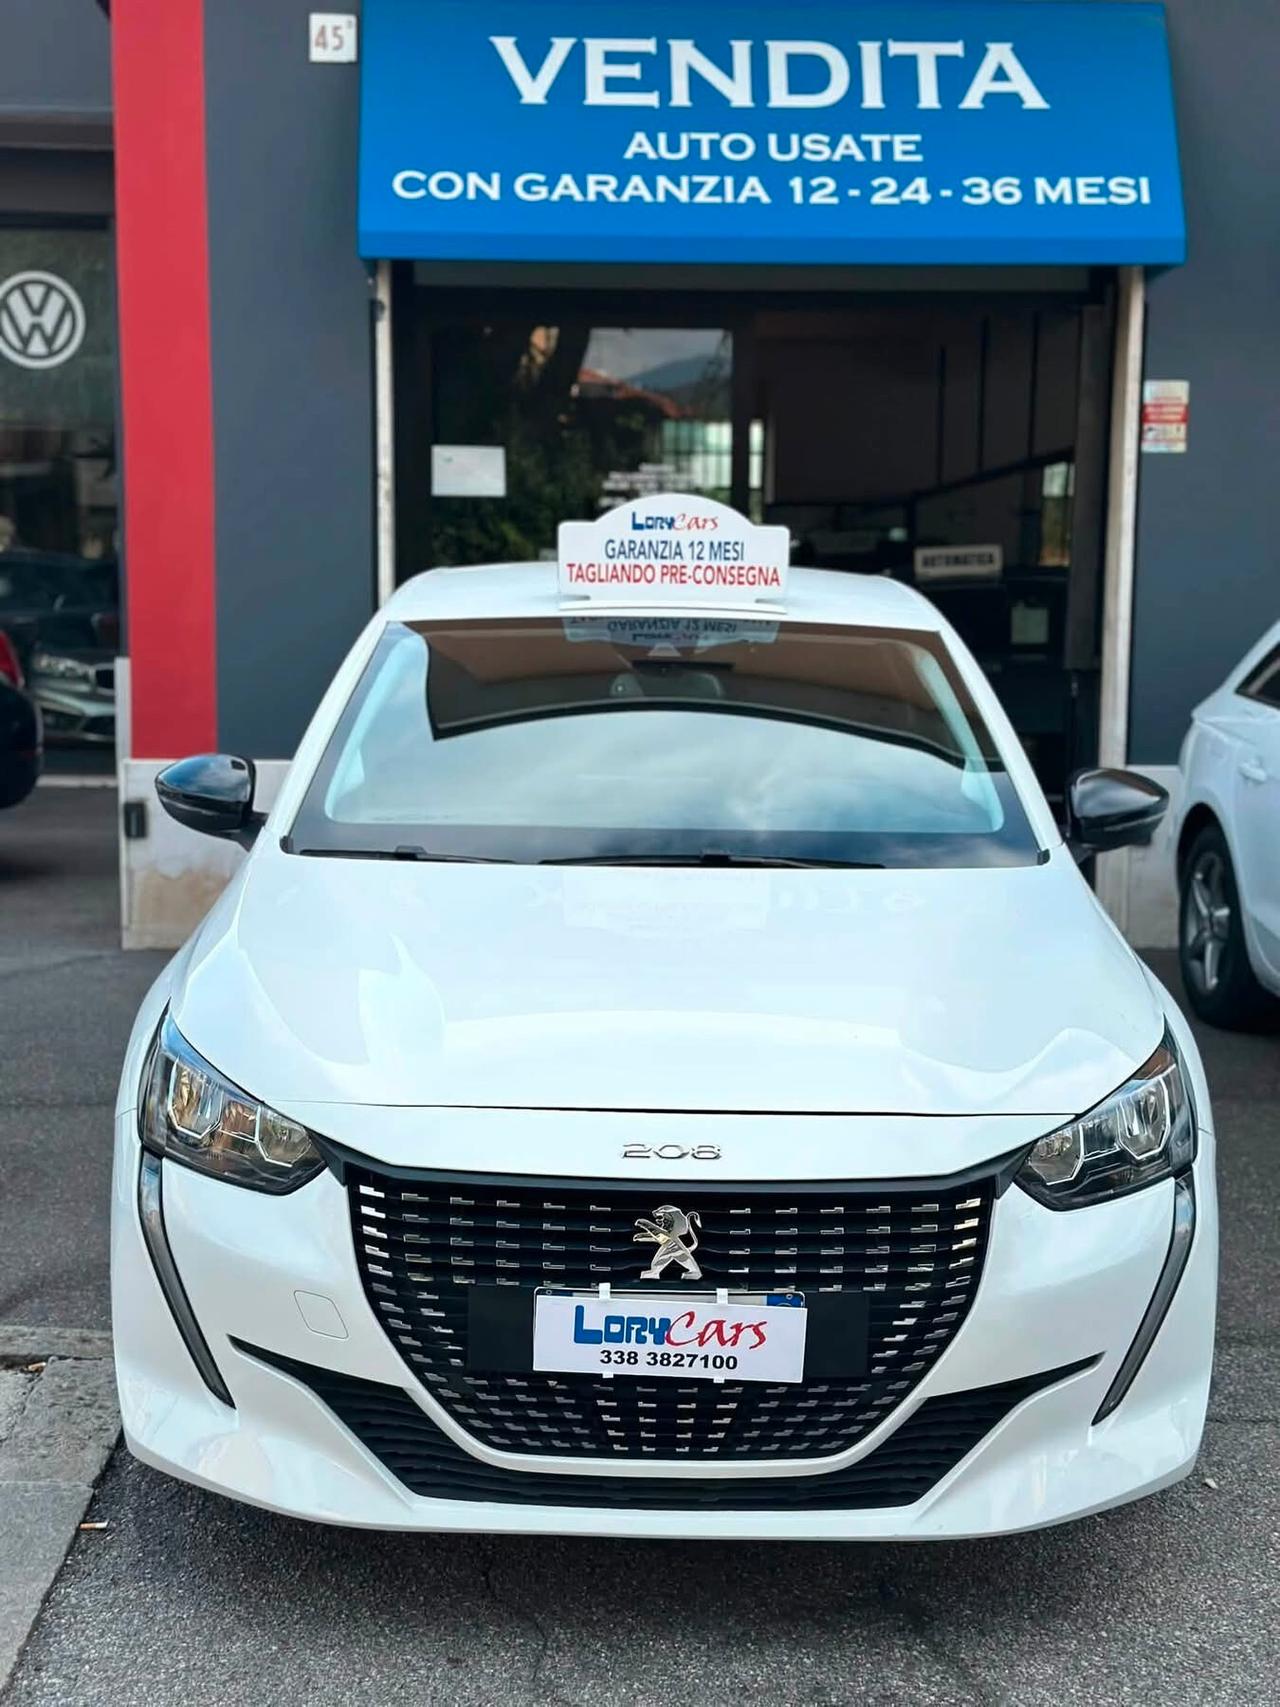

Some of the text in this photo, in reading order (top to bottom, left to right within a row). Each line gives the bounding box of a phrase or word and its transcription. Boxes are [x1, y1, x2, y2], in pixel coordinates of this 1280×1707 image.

[489, 36, 1050, 109] VENDITA
[624, 131, 923, 162] AUTO USATE
[392, 170, 500, 201] CON
[514, 173, 771, 204] GARANZIA
[789, 176, 839, 205] 12
[870, 176, 931, 205] 24
[962, 176, 1022, 205] 36
[1035, 176, 1150, 205] MESI
[604, 539, 745, 562] GARANZIA 12 MESI
[566, 563, 781, 586] TAGLIANDO PRE-CONSEGNA
[620, 1143, 723, 1161] 208
[599, 1349, 739, 1371] 338 3827100
